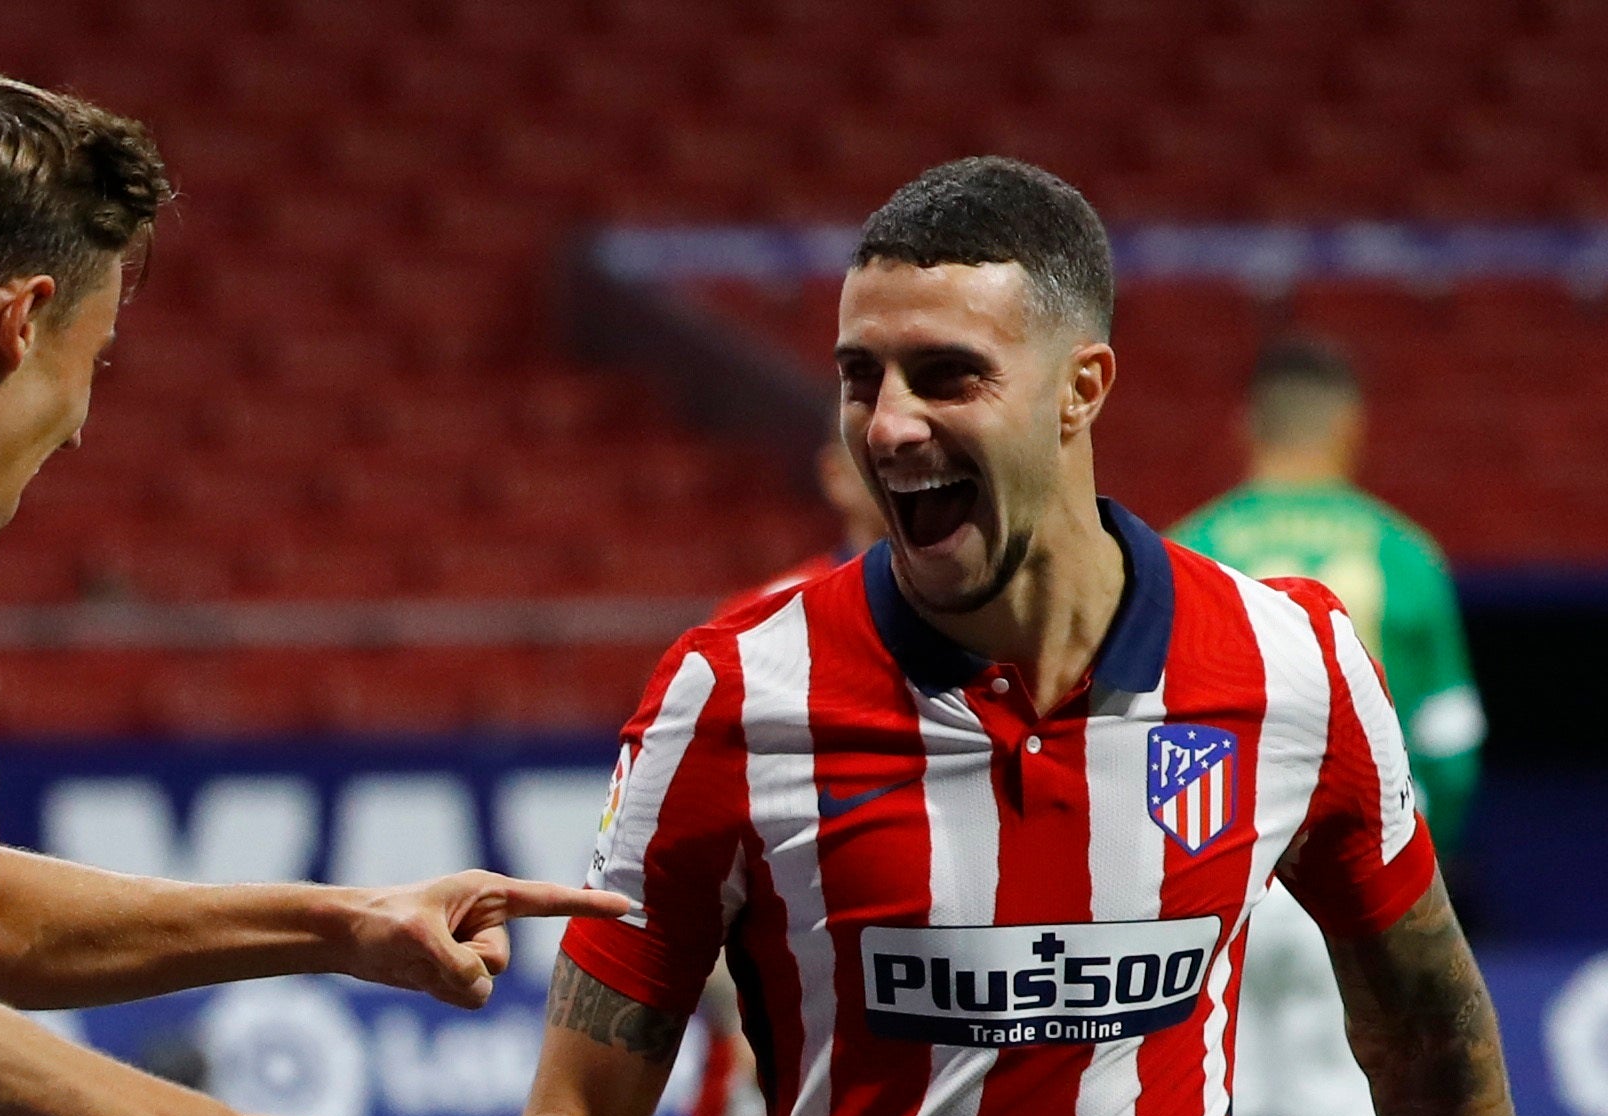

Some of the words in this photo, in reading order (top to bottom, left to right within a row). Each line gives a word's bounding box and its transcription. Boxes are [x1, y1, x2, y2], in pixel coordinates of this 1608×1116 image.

[873, 948, 1205, 1012] Plus500
[968, 1022, 1036, 1043] Trade
[1044, 1020, 1123, 1040] Online
